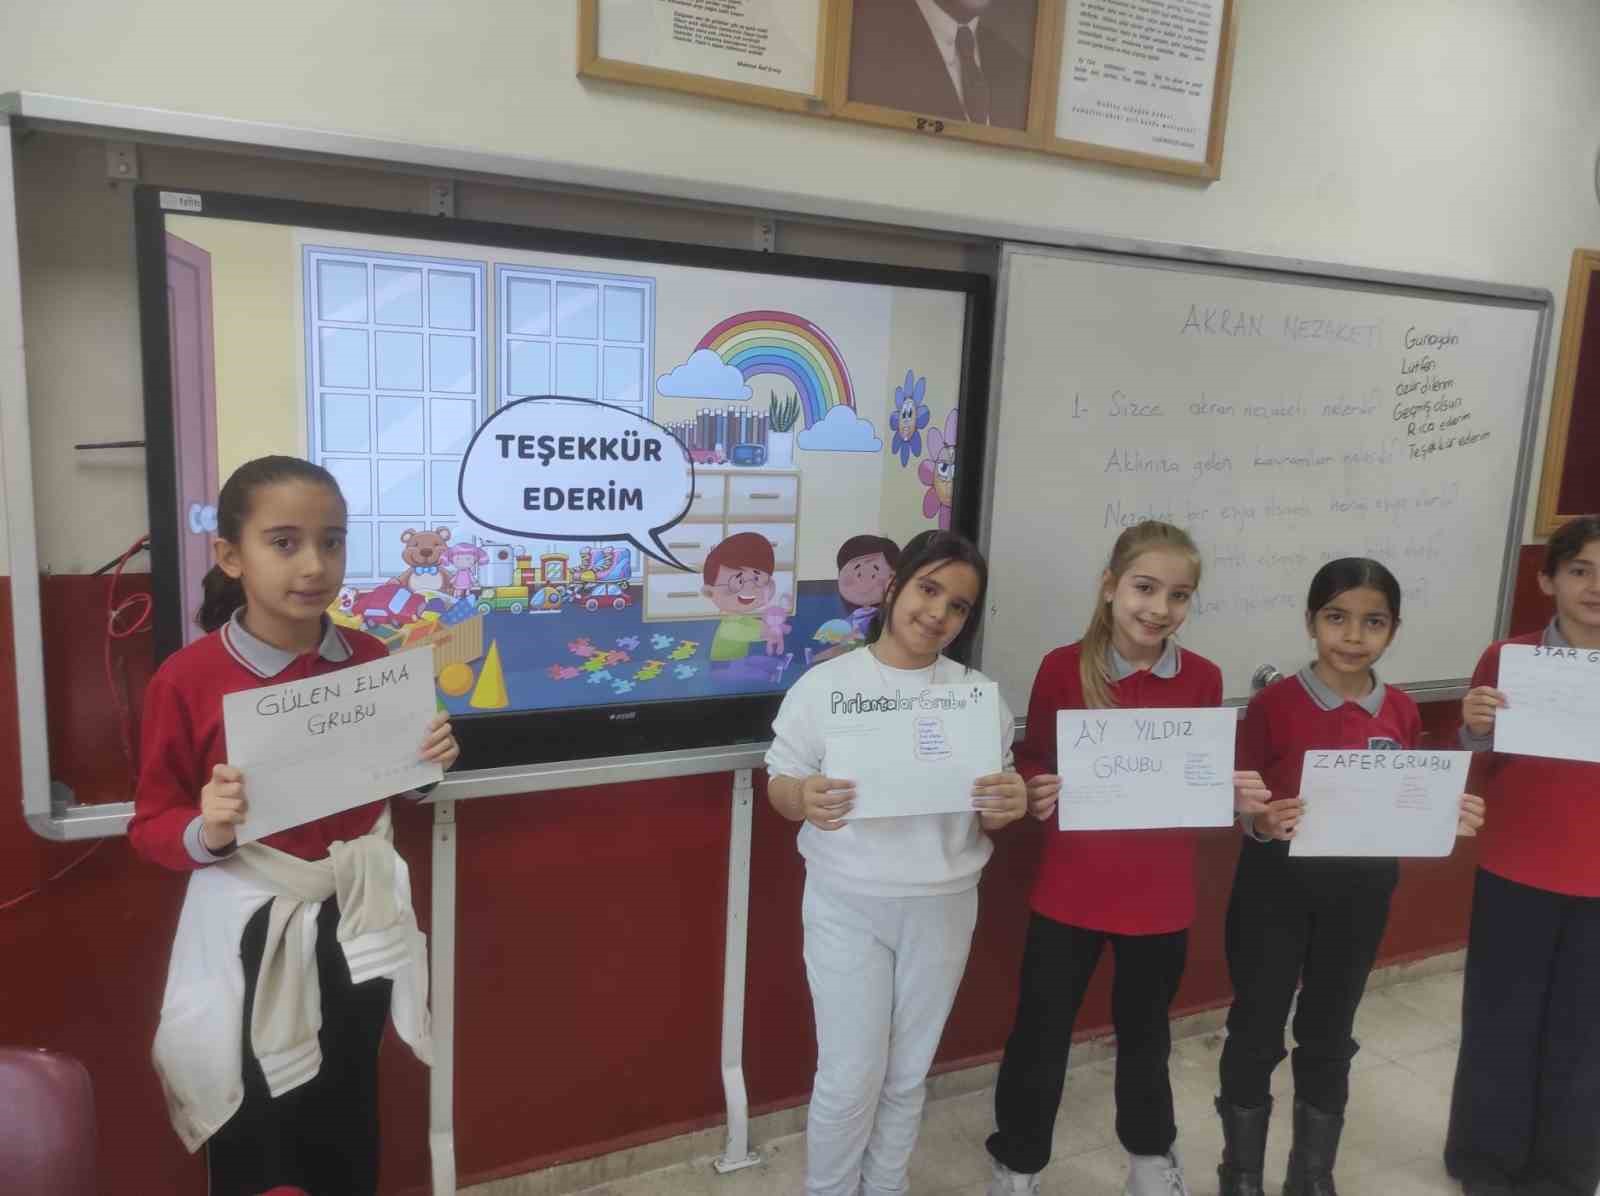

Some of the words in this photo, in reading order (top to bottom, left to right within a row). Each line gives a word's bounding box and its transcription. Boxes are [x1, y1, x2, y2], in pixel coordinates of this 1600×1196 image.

[1179, 303, 1265, 337] AKRAN
[1108, 389, 1165, 418] Sizce
[495, 430, 663, 466] TEŞEKKÜR
[523, 480, 644, 511] EDERİM
[1533, 647, 1577, 661] STAR
[256, 683, 341, 717] GÜLEN
[354, 664, 410, 693] ELMA
[307, 703, 377, 736] GRUBU
[1074, 719, 1108, 749] AY
[1135, 719, 1193, 742] YILDIZ
[1093, 754, 1163, 779] GRUBU
[1313, 753, 1386, 770] ZAFER
[1392, 754, 1451, 772] GRUBU
